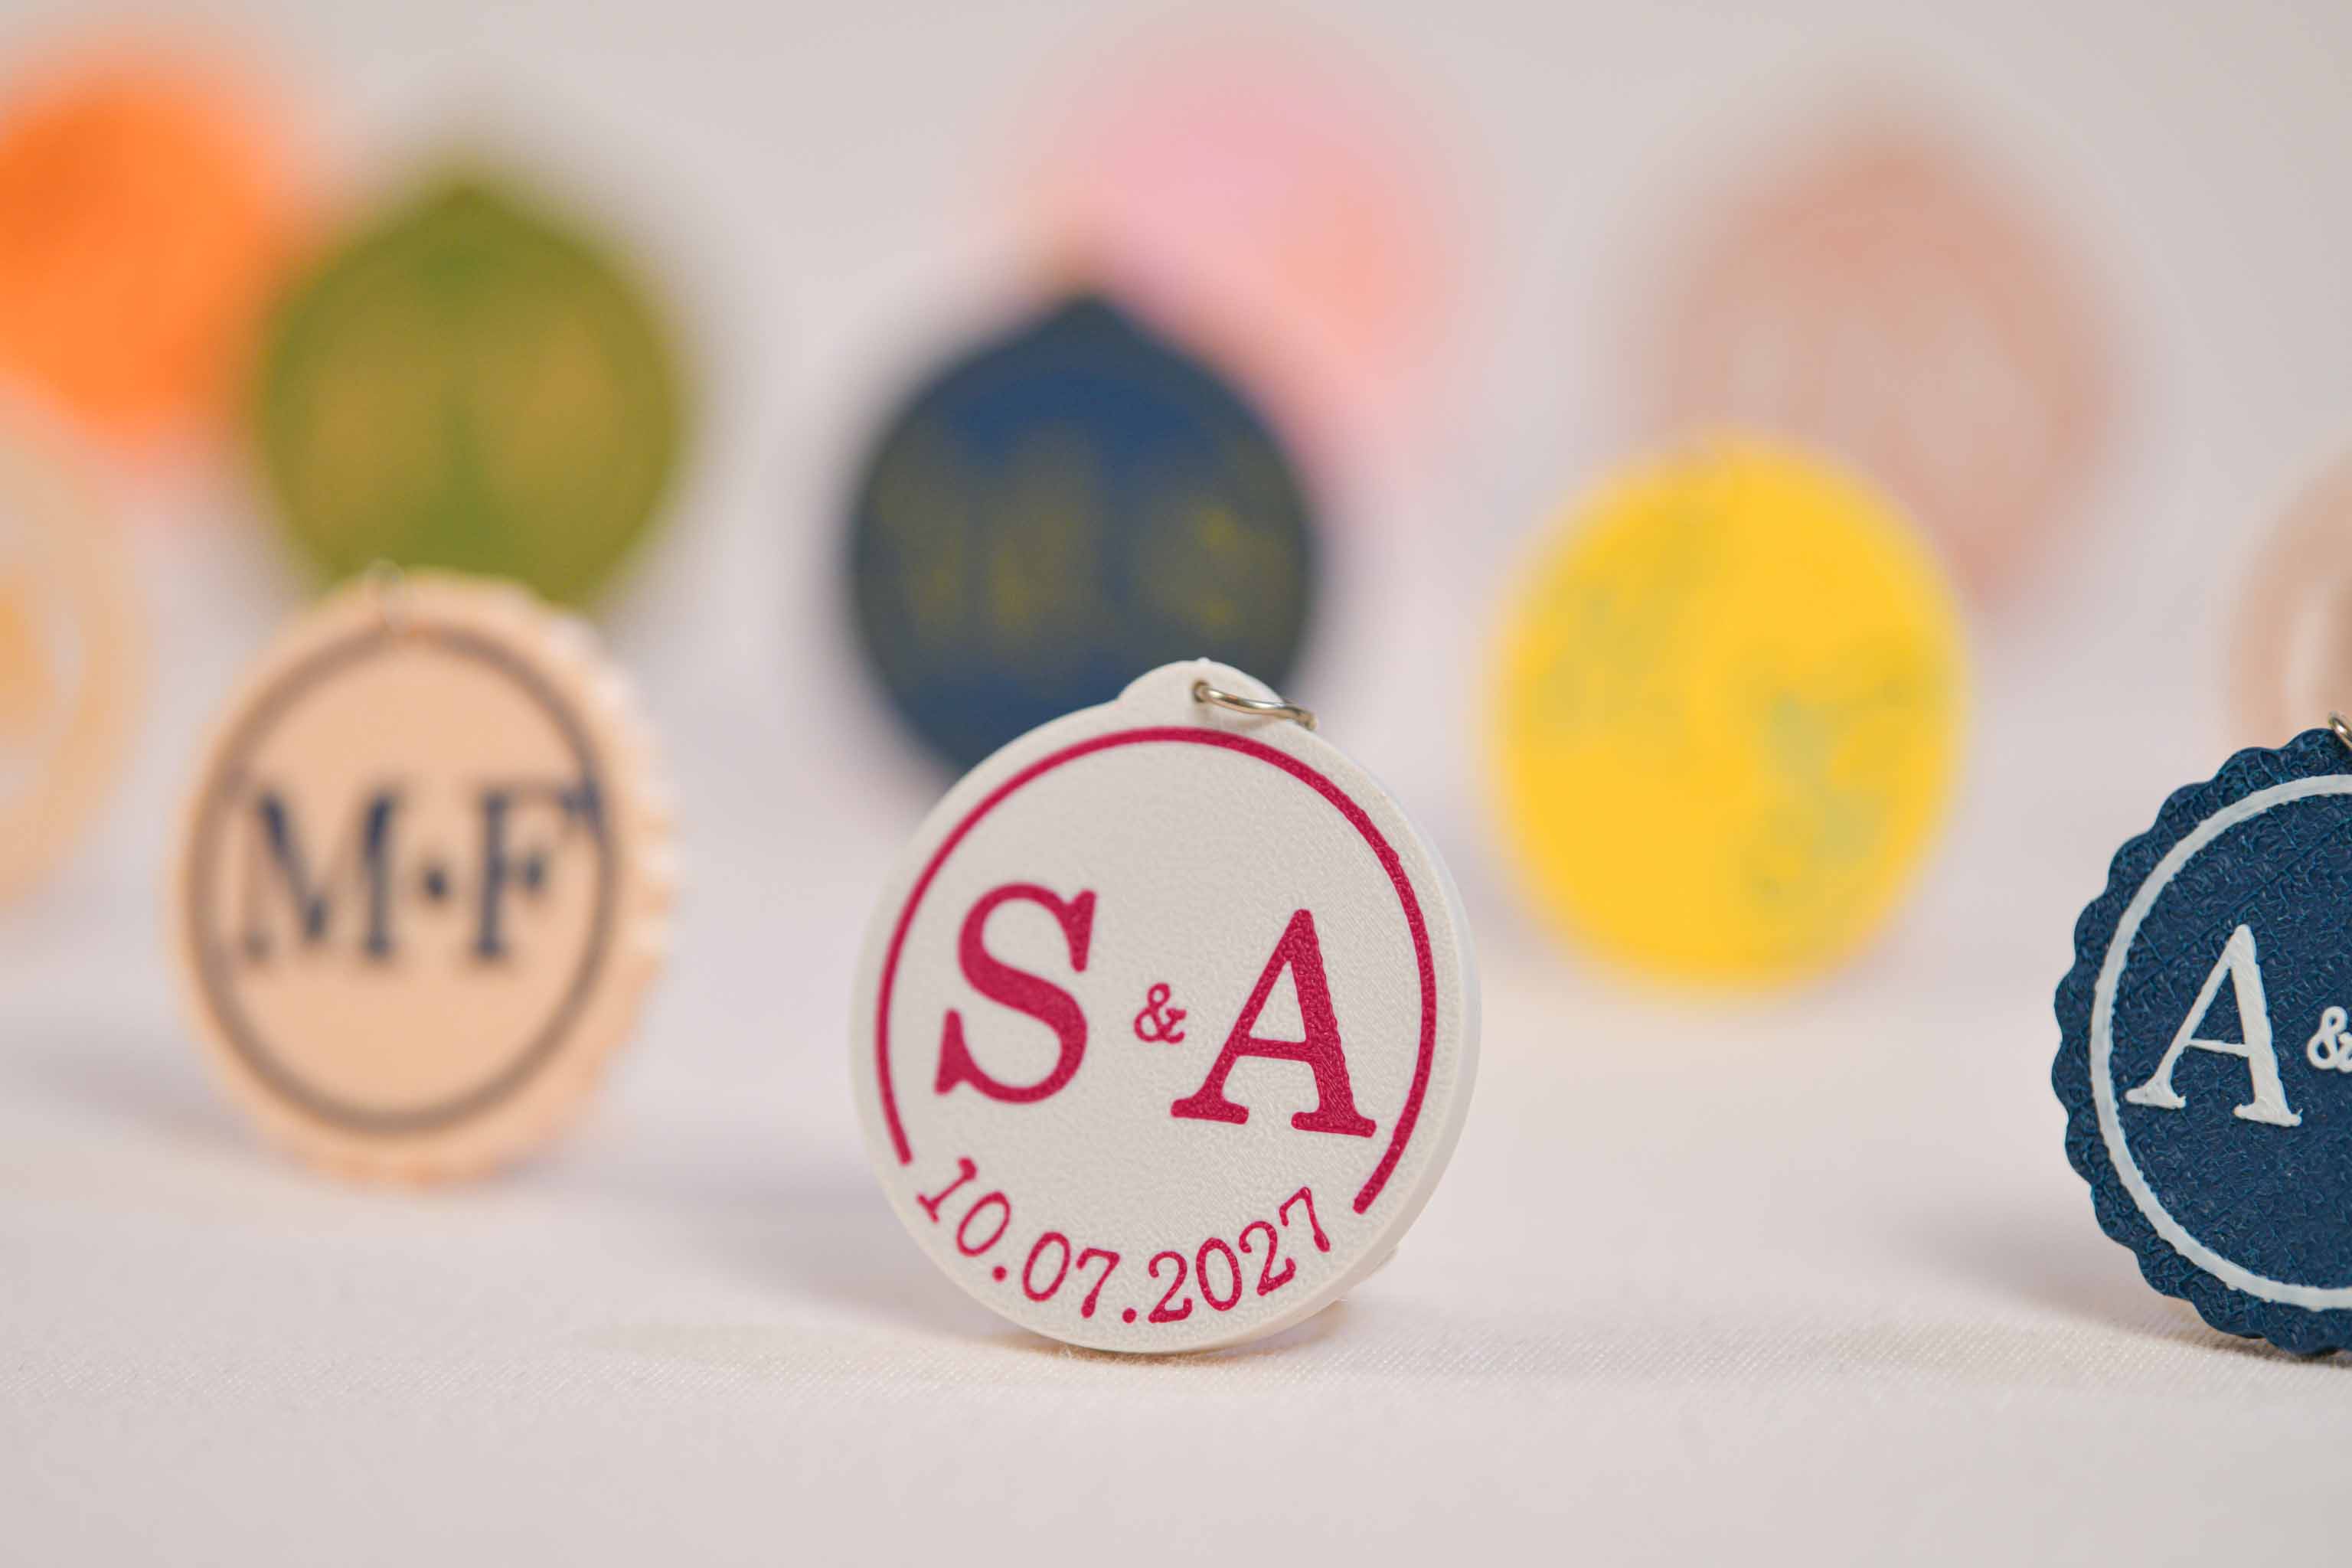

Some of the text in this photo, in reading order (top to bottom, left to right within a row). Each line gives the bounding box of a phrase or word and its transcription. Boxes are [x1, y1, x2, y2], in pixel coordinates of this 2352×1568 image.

[933, 881, 1378, 1140] S & A
[2125, 923, 2302, 1128] A
[916, 1155, 1332, 1325] 10.07.2027
